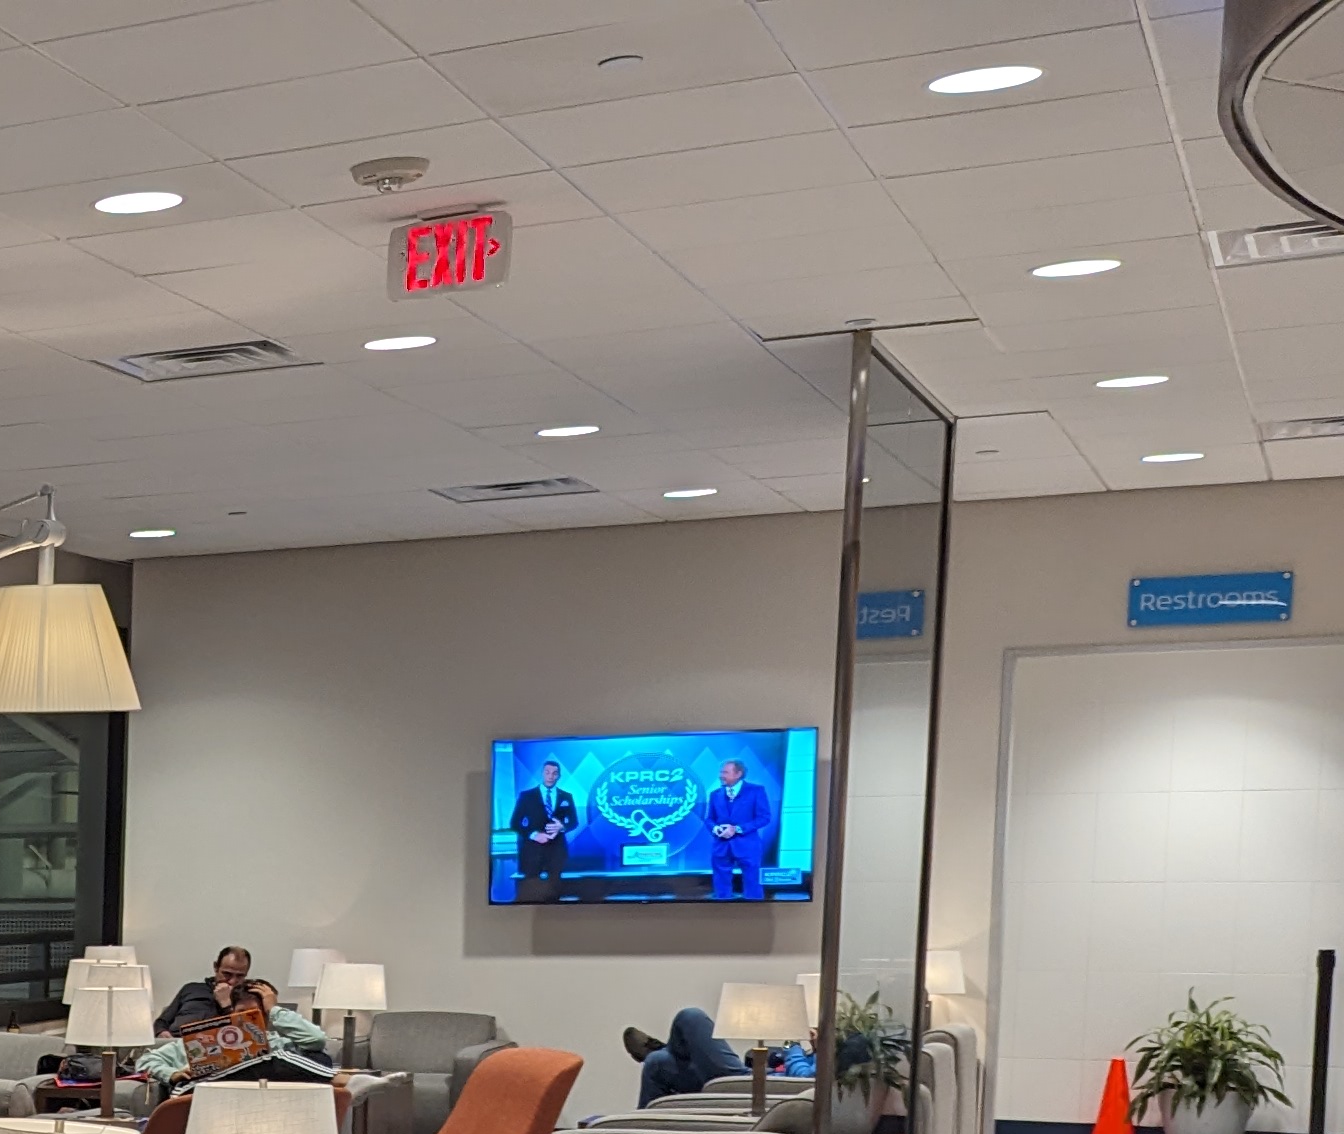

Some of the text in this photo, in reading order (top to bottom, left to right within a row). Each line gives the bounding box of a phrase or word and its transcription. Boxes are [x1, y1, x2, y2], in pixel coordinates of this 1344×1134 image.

[405, 216, 493, 292] EXIT
[1140, 590, 1279, 611] Restrooms
[628, 784, 668, 795] Senior
[610, 795, 684, 807] Scholarships
